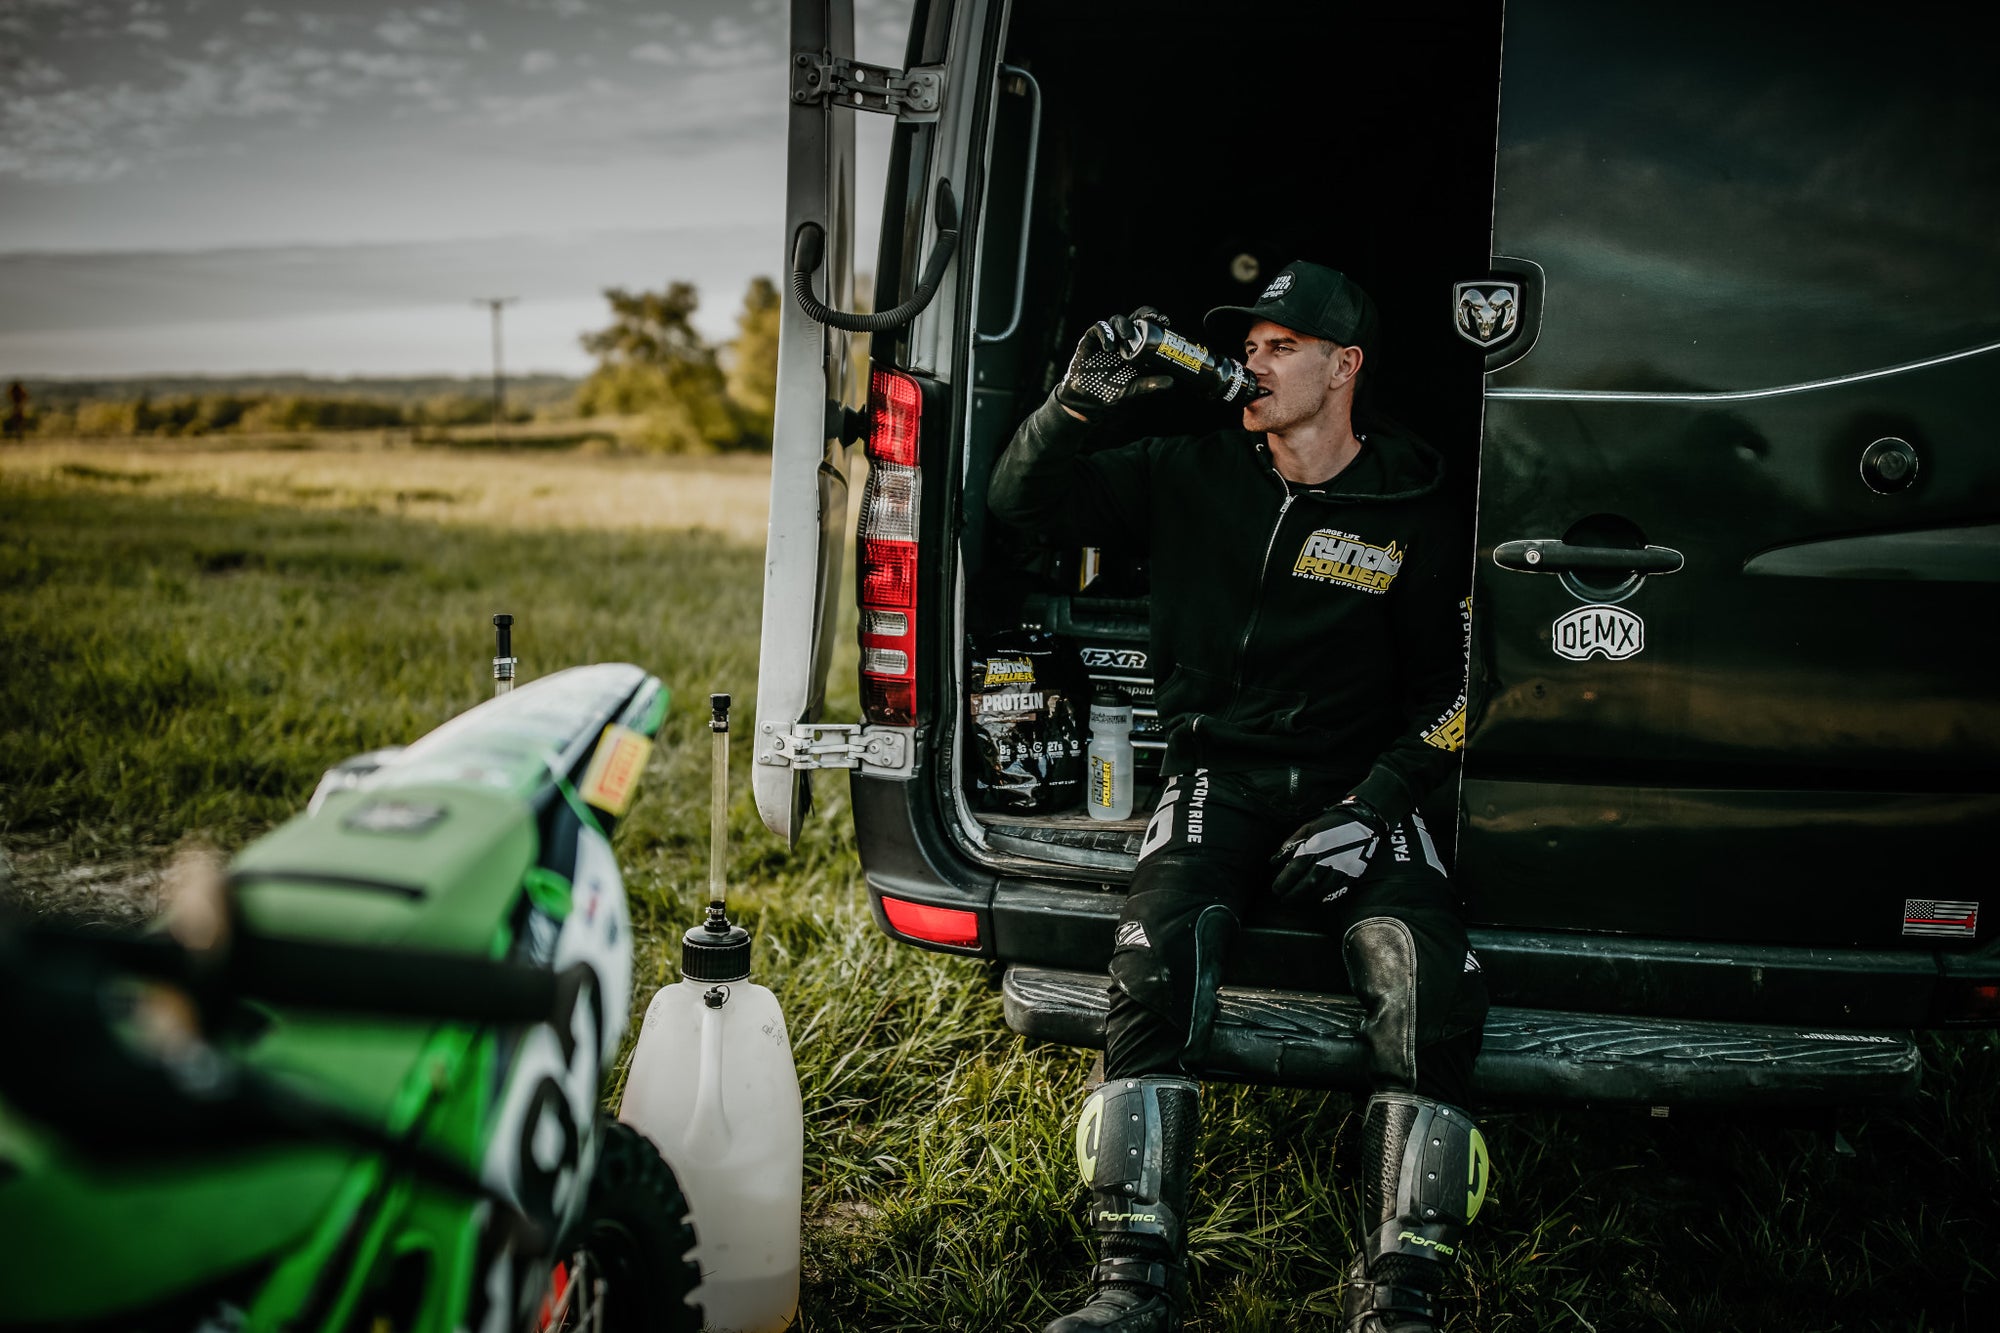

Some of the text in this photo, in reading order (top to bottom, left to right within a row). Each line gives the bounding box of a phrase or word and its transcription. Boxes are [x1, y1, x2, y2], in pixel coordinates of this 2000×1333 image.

[1158, 343, 1202, 371] POWER
[1303, 535, 1385, 571] RYNO
[1292, 571, 1325, 582] SPORTS
[1298, 556, 1394, 589] POWER
[1563, 614, 1635, 652] DEMX
[1080, 648, 1147, 668] FXR
[986, 672, 1033, 683] POWER
[982, 692, 1044, 712] PROTEIN
[1102, 762, 1111, 807] POWER
[1187, 811, 1204, 843] RIDE
